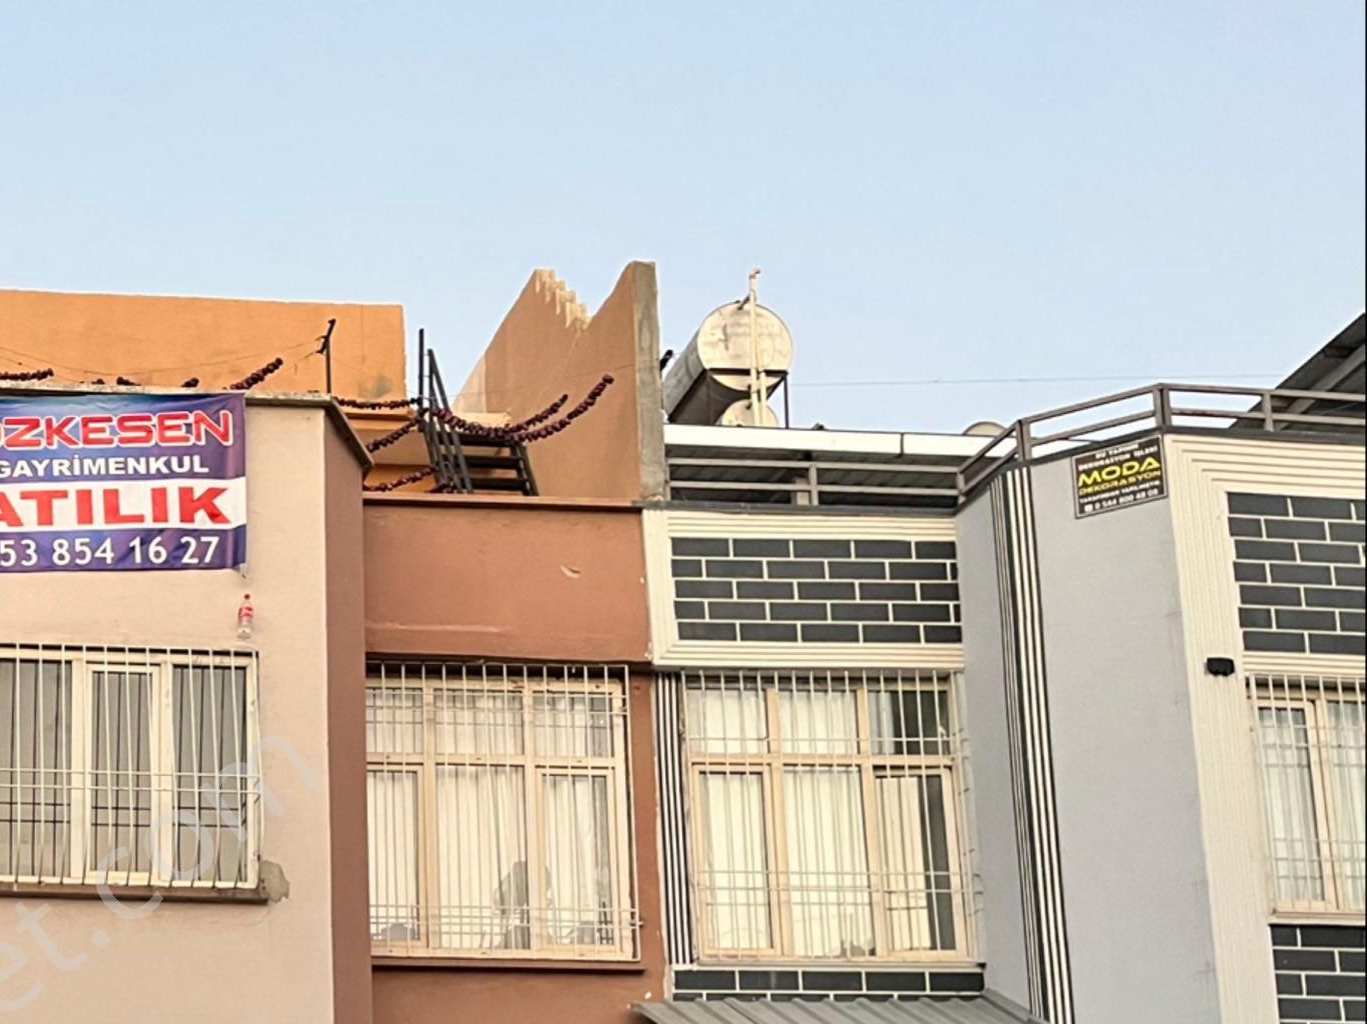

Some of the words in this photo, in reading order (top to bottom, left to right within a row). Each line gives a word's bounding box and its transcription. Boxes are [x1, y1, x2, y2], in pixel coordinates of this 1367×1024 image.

[1078, 457, 1160, 486] MODA
[1079, 471, 1160, 495] DEKORASYON
[52, 539, 115, 565] 854
[130, 537, 168, 565] 16
[181, 536, 220, 563] 27
